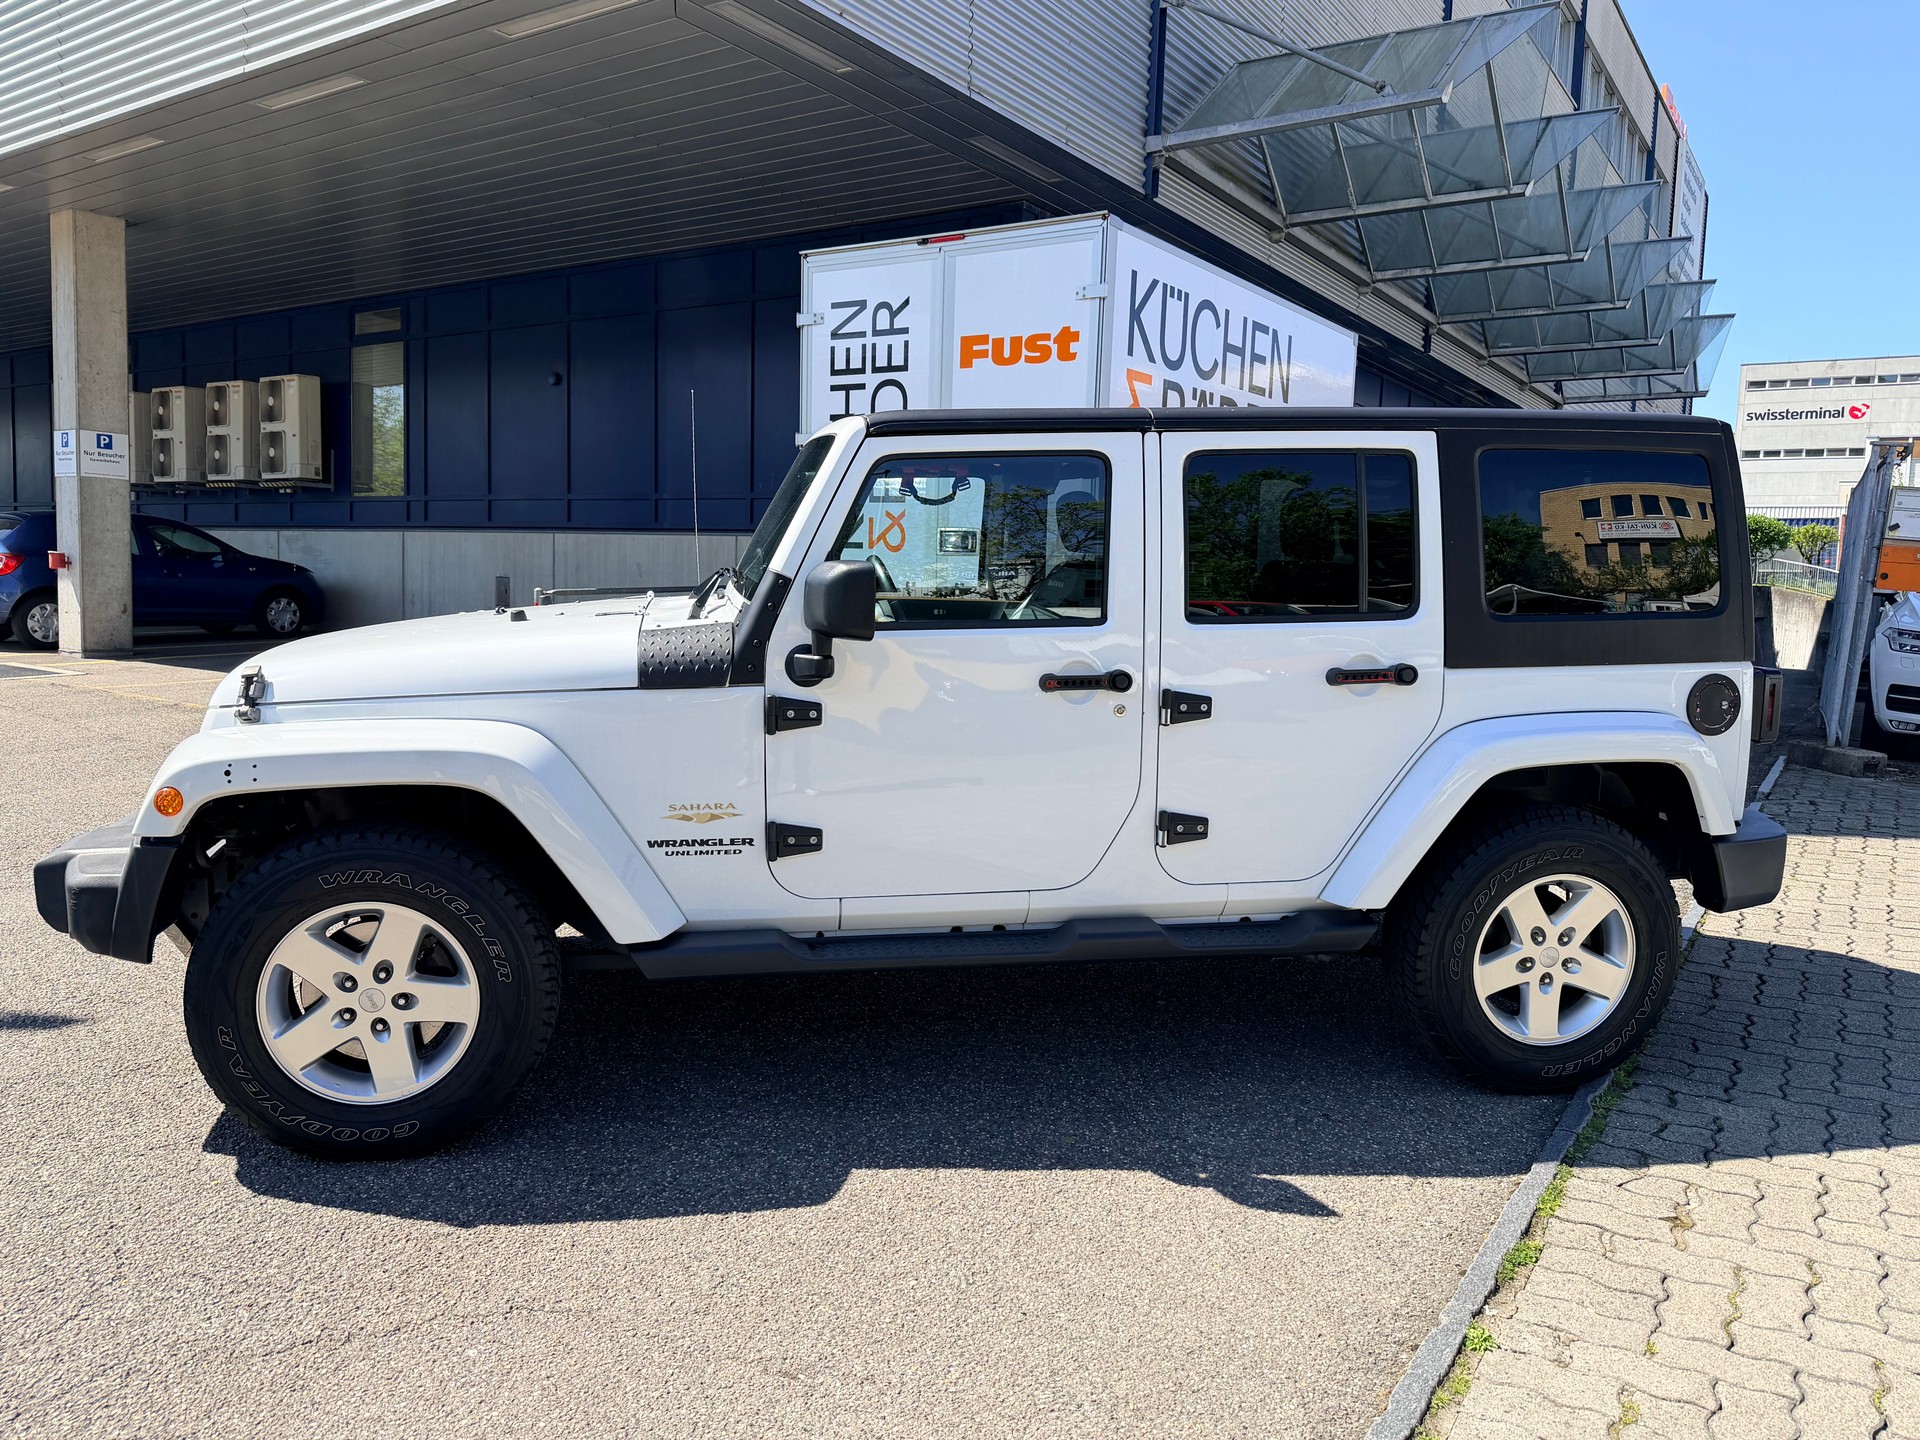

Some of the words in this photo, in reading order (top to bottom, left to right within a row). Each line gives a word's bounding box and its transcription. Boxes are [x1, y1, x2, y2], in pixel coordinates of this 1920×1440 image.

[829, 299, 867, 422] HEN
[870, 295, 910, 411] DER
[959, 325, 1080, 369] Fust
[1127, 269, 1292, 404] KÜCHEN
[97, 451, 126, 459] Besucher
[1745, 406, 1845, 421] swissterminal
[647, 838, 755, 848] WRANGLER
[668, 803, 736, 812] SAHARA
[317, 869, 513, 984] WRANGLER
[1448, 846, 1585, 981] GOODYEAR
[1541, 950, 1668, 1078] WRANGLER
[217, 1024, 421, 1142] GOODYEAR
